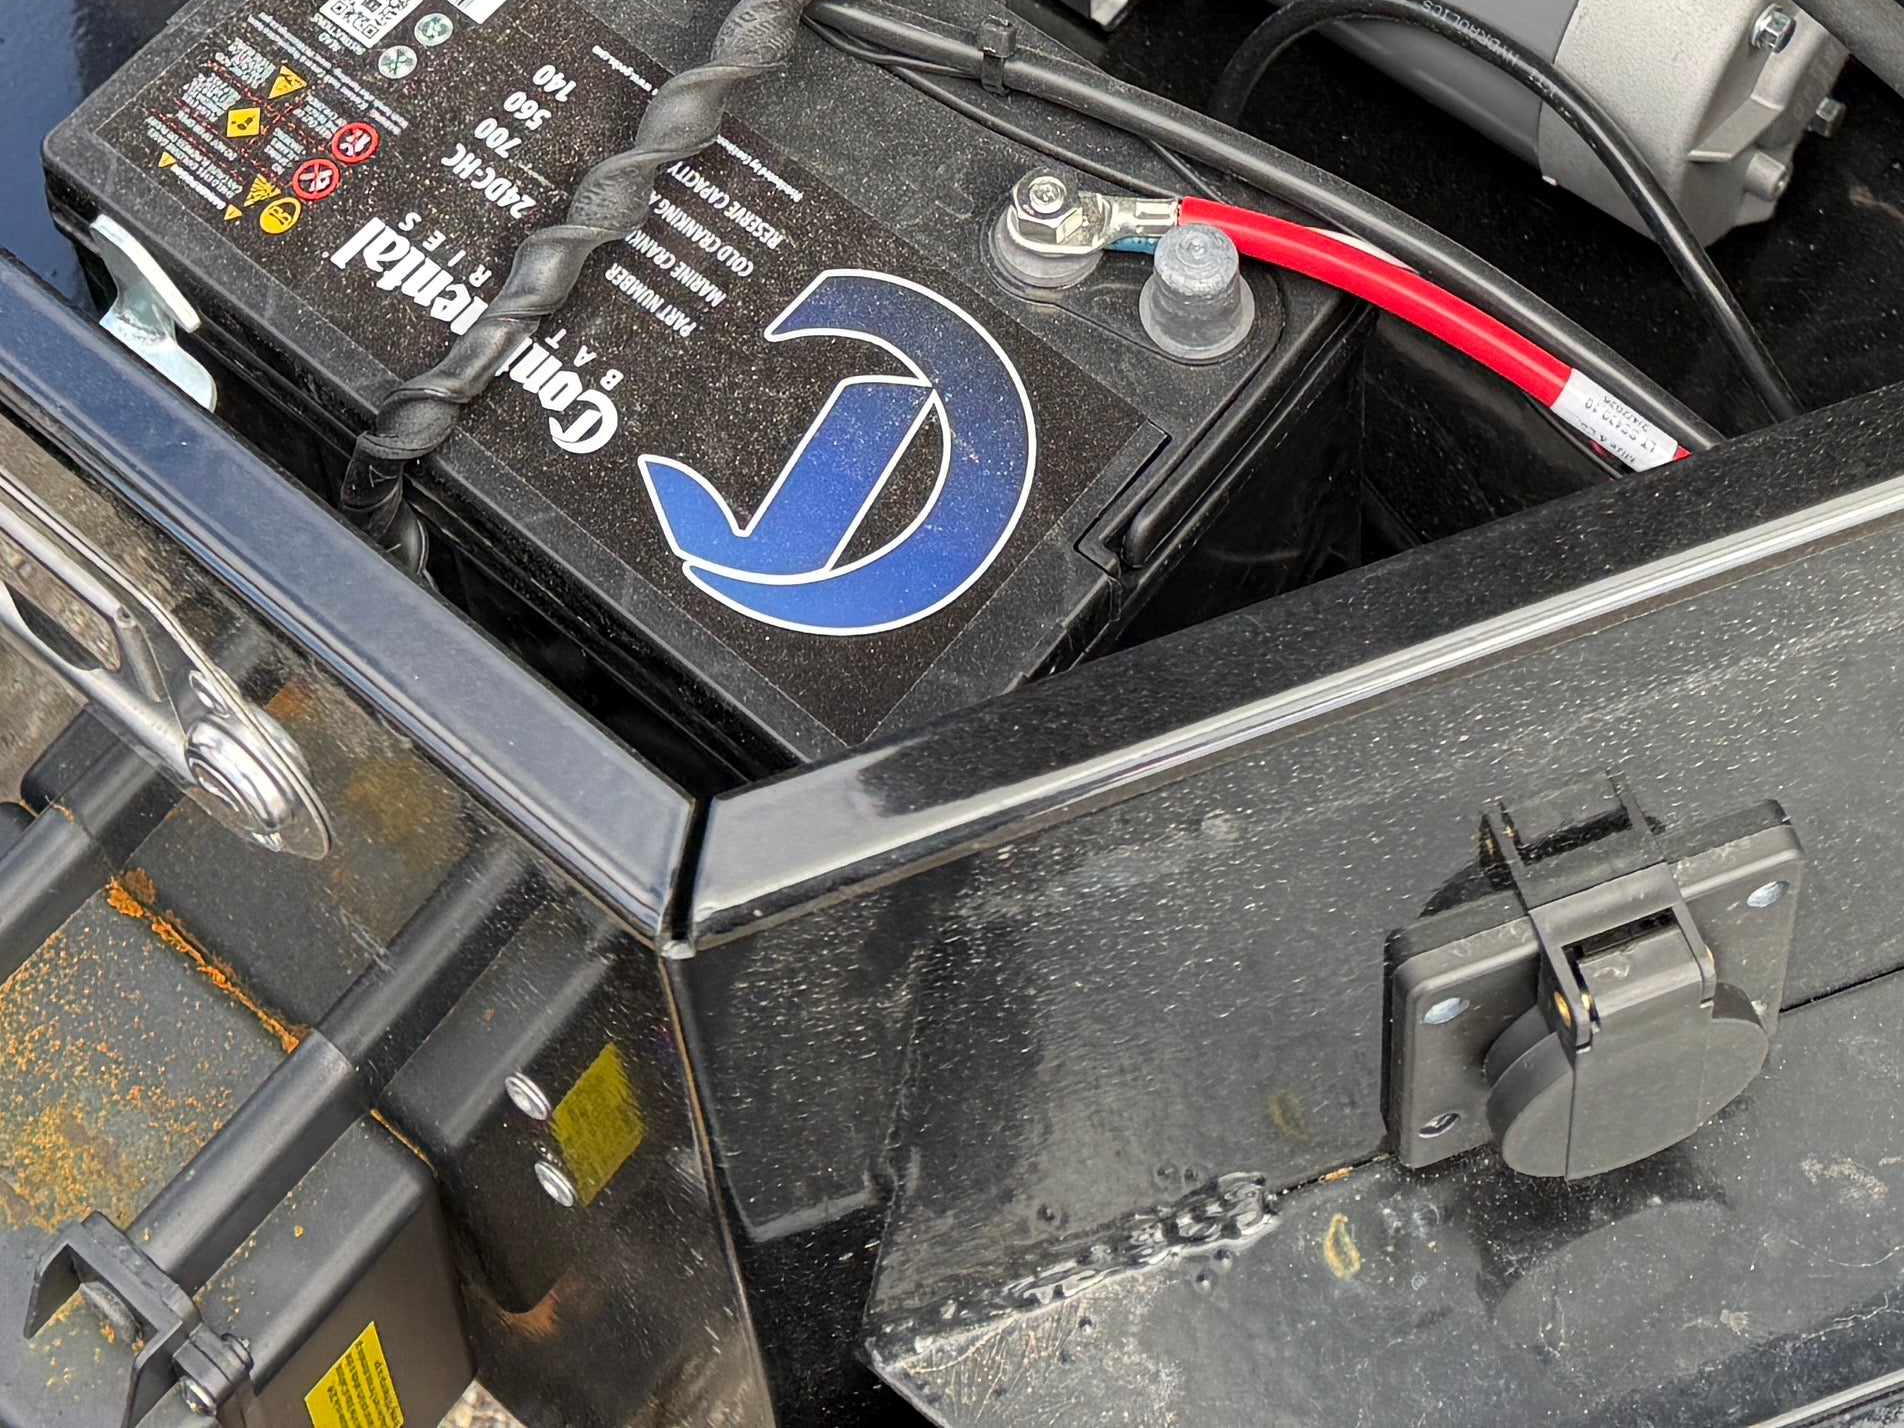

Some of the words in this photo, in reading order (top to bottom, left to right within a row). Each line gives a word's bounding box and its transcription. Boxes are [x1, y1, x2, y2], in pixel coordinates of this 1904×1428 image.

[309, 12, 367, 56] INSTRUCTIONS
[528, 60, 581, 103] 140
[499, 87, 553, 131] 560
[469, 113, 525, 159] 700
[438, 141, 538, 220] 24DC-HC
[664, 157, 734, 211] CAPACITY
[650, 196, 725, 255] CRANKING
[722, 198, 786, 249] RESERVE
[622, 226, 679, 272] CRANKI
[712, 241, 758, 279] COLD
[394, 210, 623, 387] BATRIES
[601, 261, 666, 313] NUMBER
[667, 259, 728, 308] MARINE
[655, 301, 699, 338] PART
